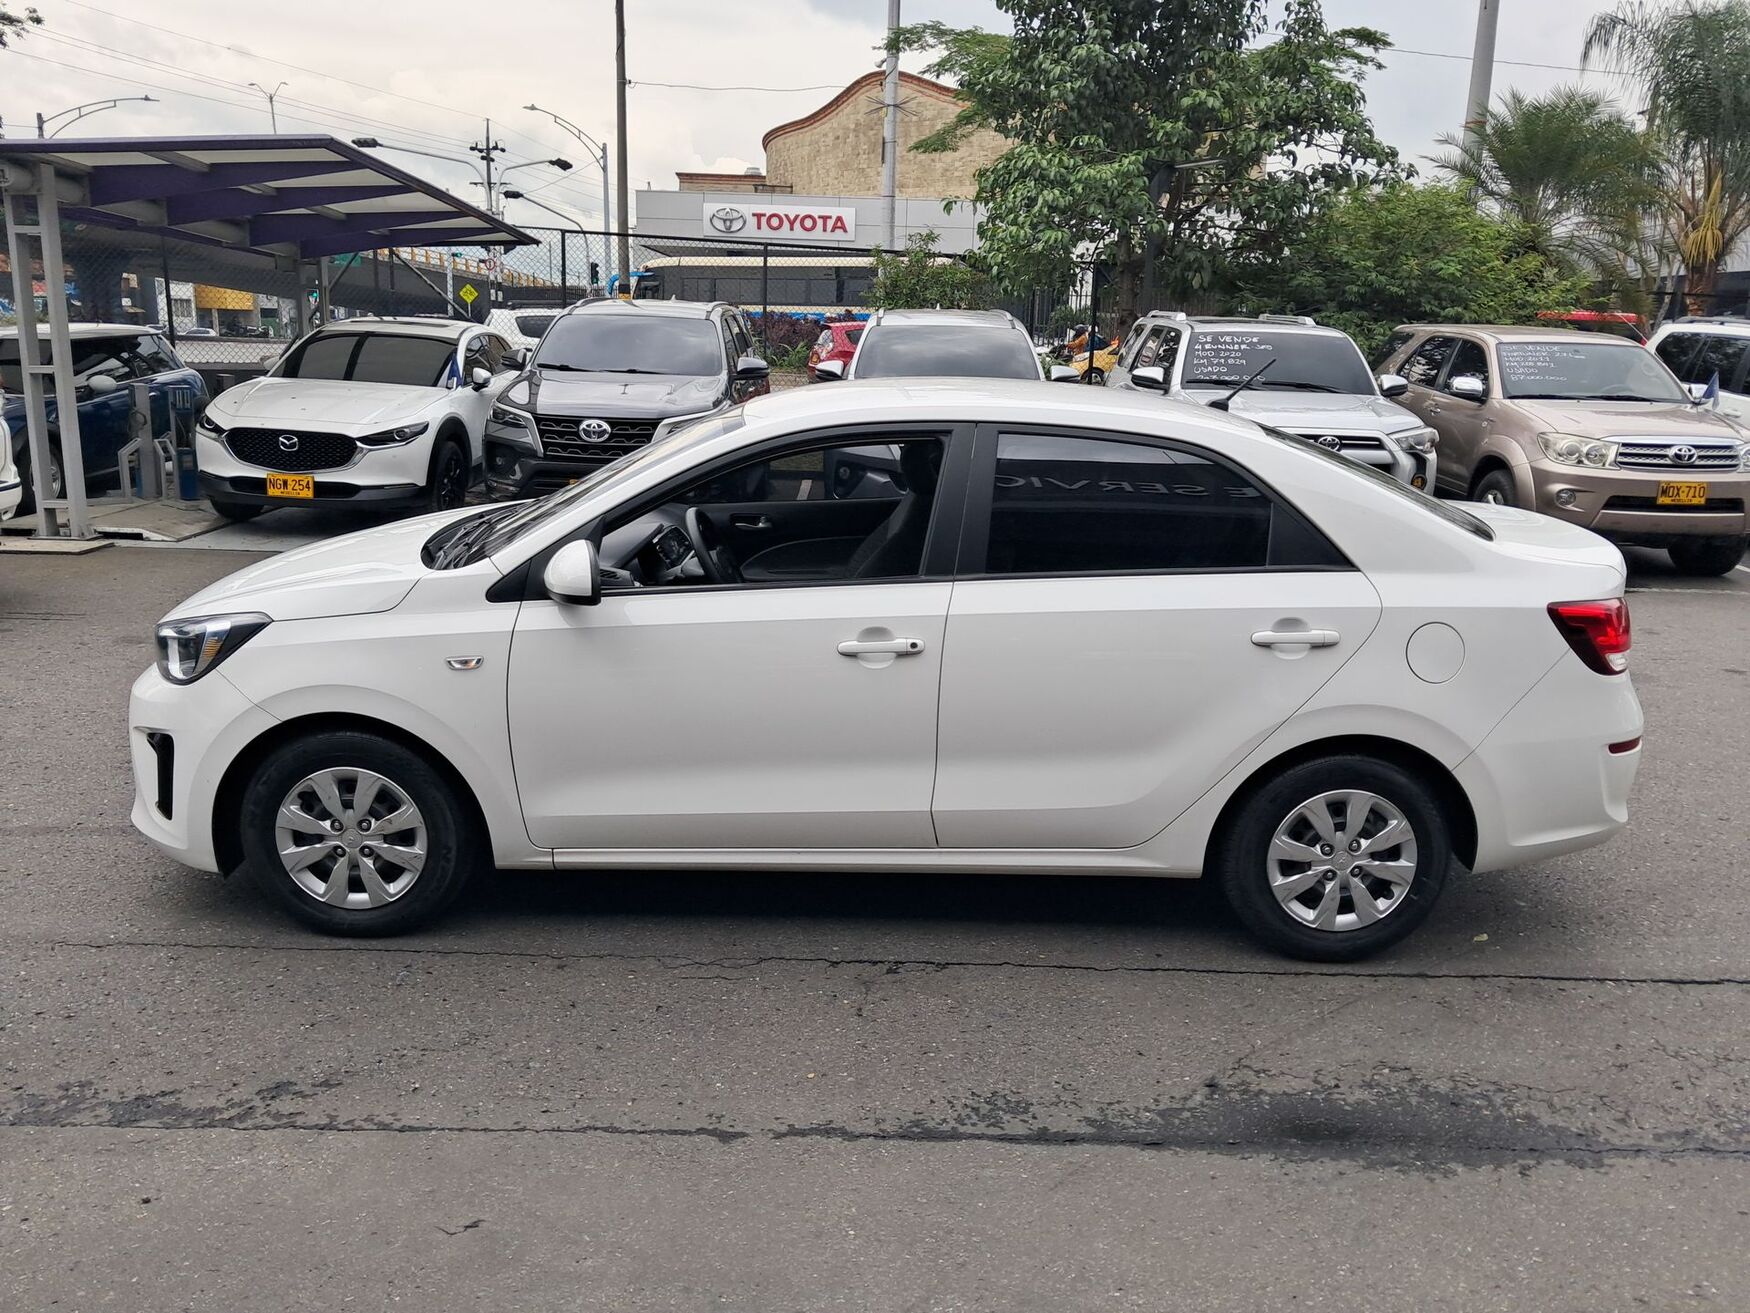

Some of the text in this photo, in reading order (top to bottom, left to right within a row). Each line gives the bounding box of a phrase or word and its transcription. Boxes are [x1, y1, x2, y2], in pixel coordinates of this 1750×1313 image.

[752, 212, 848, 233] TOYOTA
[1198, 334, 1260, 343] SE VENDE
[1193, 366, 1227, 374] USADO
[269, 478, 311, 491] NGW 254
[1686, 485, 1705, 498] 710
